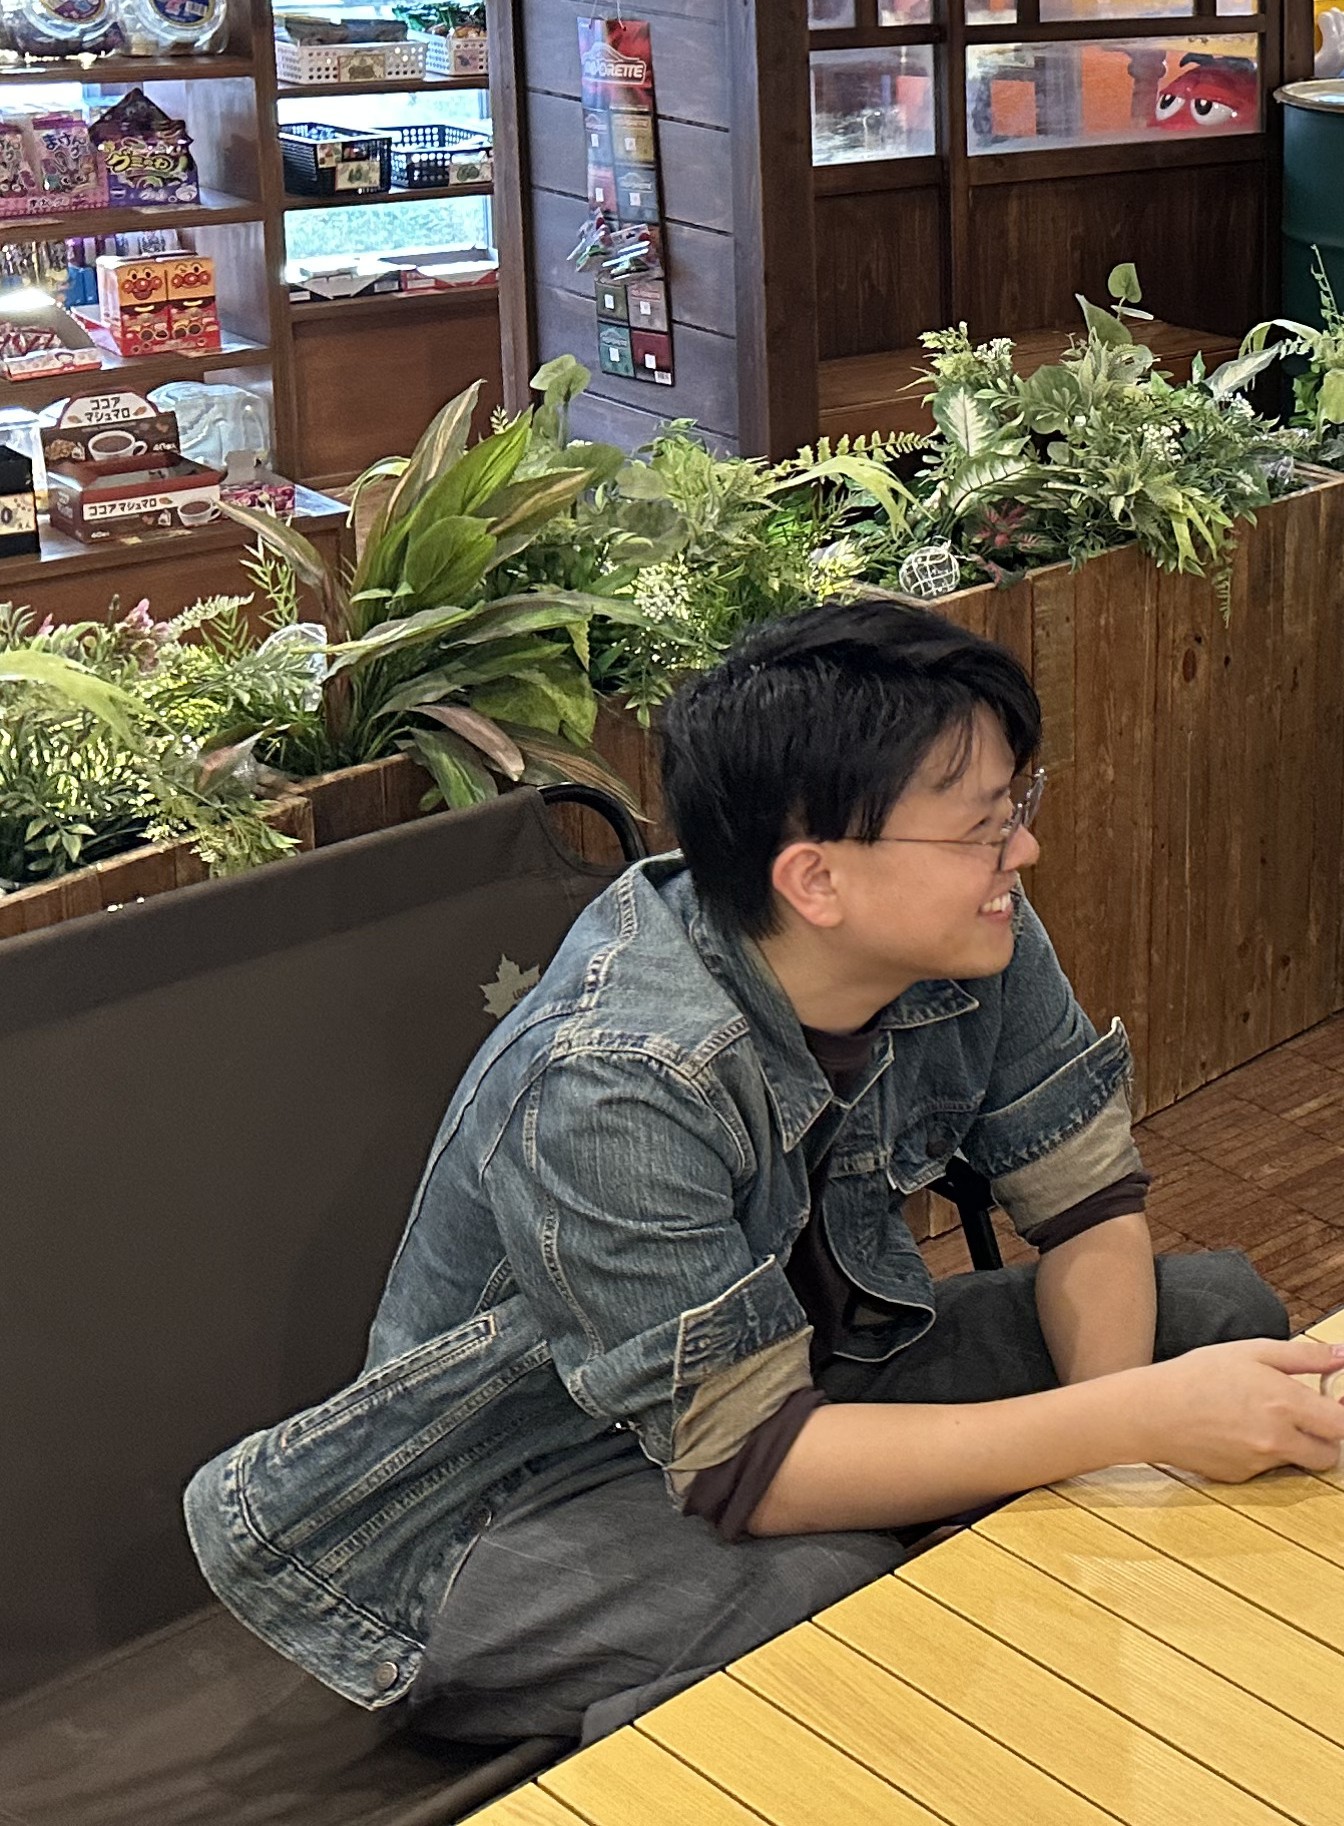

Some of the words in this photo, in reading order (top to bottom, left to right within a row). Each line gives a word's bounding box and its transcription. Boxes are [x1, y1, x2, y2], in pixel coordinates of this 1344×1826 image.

[90, 397, 120, 411] ココア
[85, 408, 130, 423] マシュマロ
